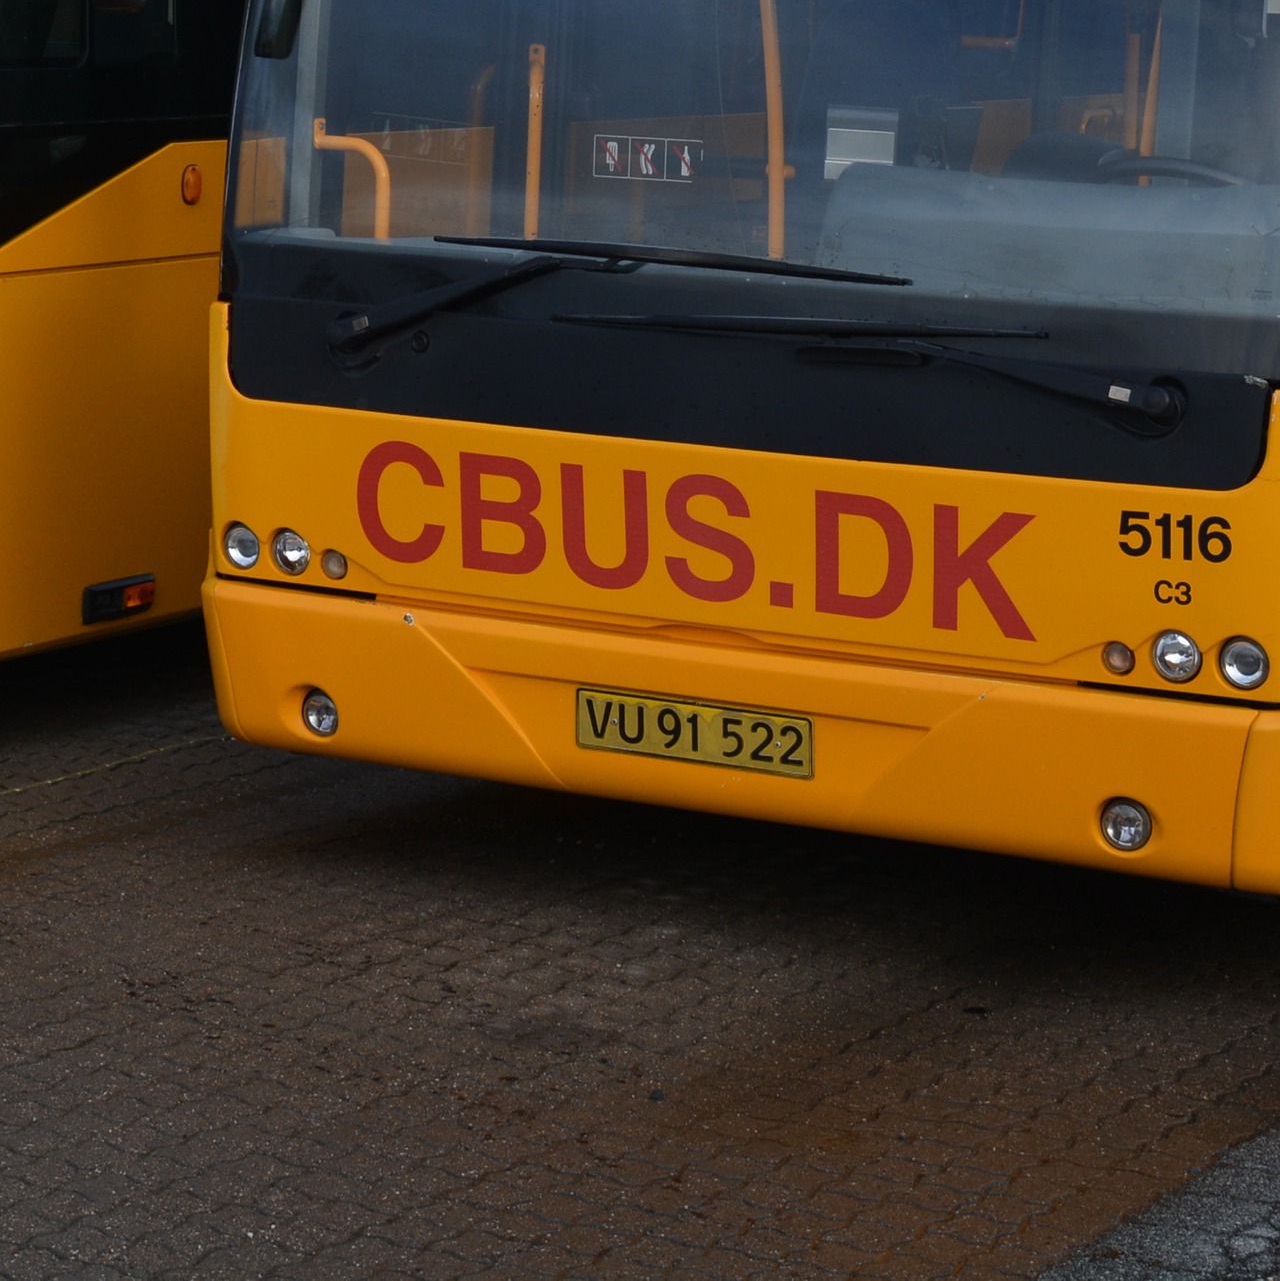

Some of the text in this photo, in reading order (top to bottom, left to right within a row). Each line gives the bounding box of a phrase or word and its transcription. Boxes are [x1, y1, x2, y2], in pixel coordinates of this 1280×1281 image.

[356, 440, 1038, 643] CBUS.DK
[1118, 510, 1232, 563] 5116
[1153, 580, 1192, 605] C3
[585, 698, 804, 767] VU 91 522
